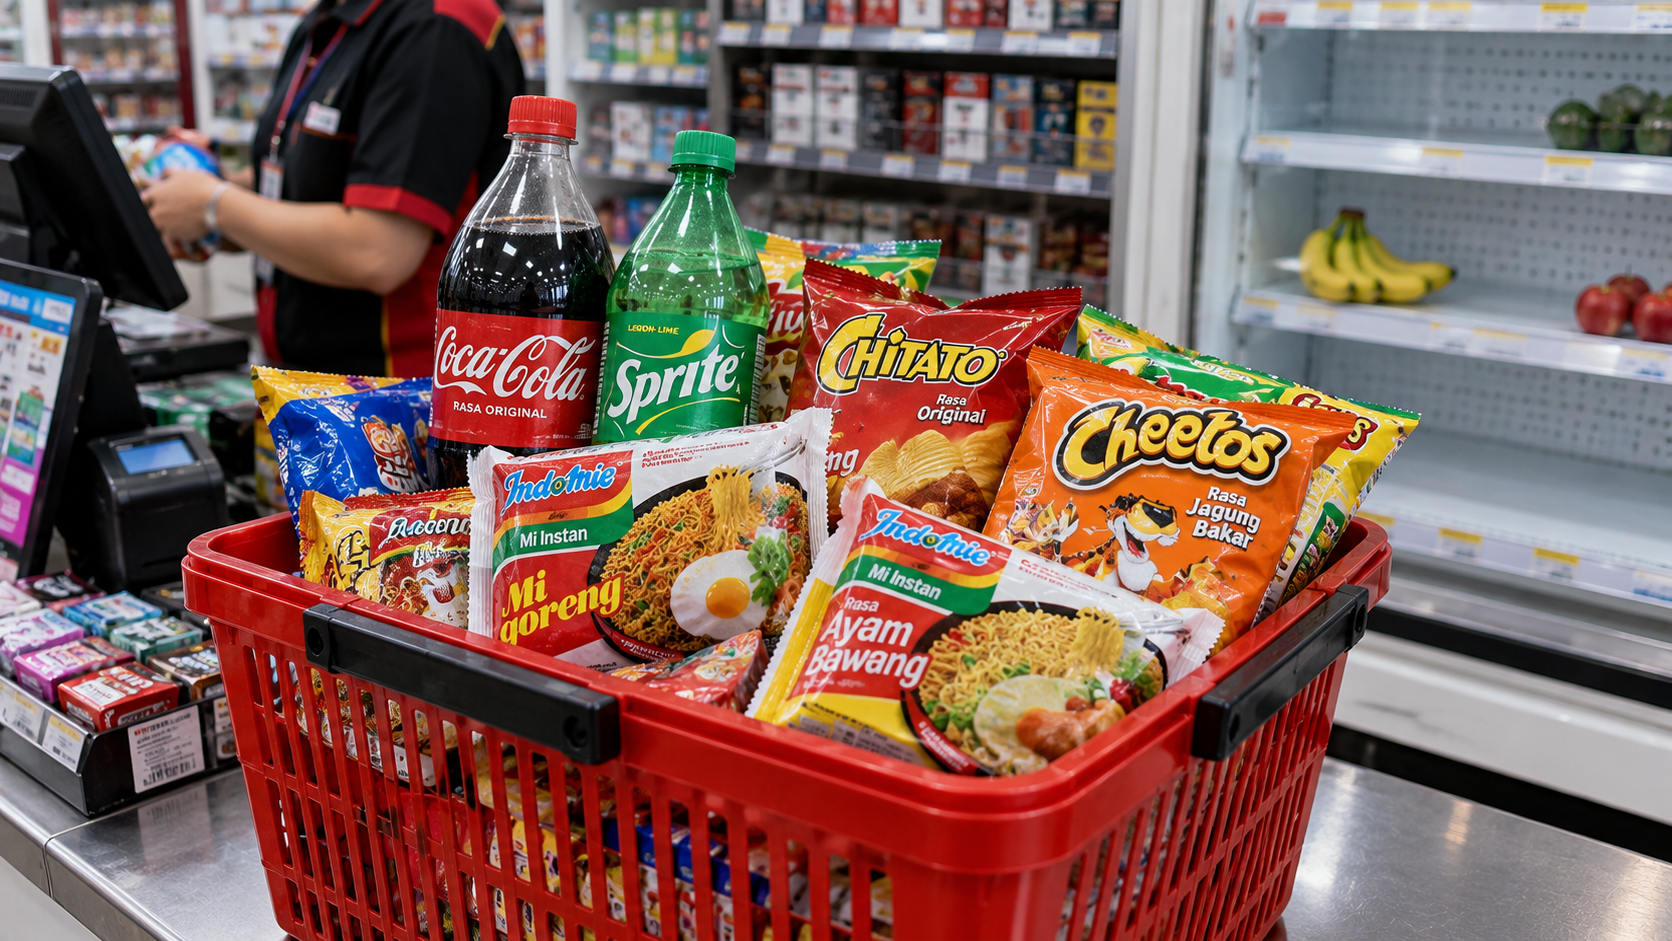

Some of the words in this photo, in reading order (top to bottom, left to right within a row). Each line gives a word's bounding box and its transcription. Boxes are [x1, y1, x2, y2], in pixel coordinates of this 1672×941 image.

[435, 326, 595, 401] Coca-Cola
[607, 344, 739, 425] Sprite
[936, 394, 967, 406] Rasa
[453, 401, 482, 414] RASA
[485, 405, 547, 418] ORIGINAL
[917, 406, 987, 425] Original
[1060, 404, 1284, 480] Cheetos
[501, 463, 617, 515] Indomie
[1207, 486, 1247, 507] Rasa
[1185, 498, 1261, 534] Jagung
[1192, 519, 1254, 549] Bakar
[520, 531, 537, 549] Mi
[540, 528, 588, 546] Instan
[858, 509, 991, 566] Indomie
[502, 569, 548, 617] Mi
[868, 564, 890, 581] Mi
[889, 569, 942, 600] Instan
[500, 576, 622, 645] goreng
[844, 596, 880, 613] Rasa
[820, 610, 914, 648] Ayam
[805, 645, 929, 688] Bawang
